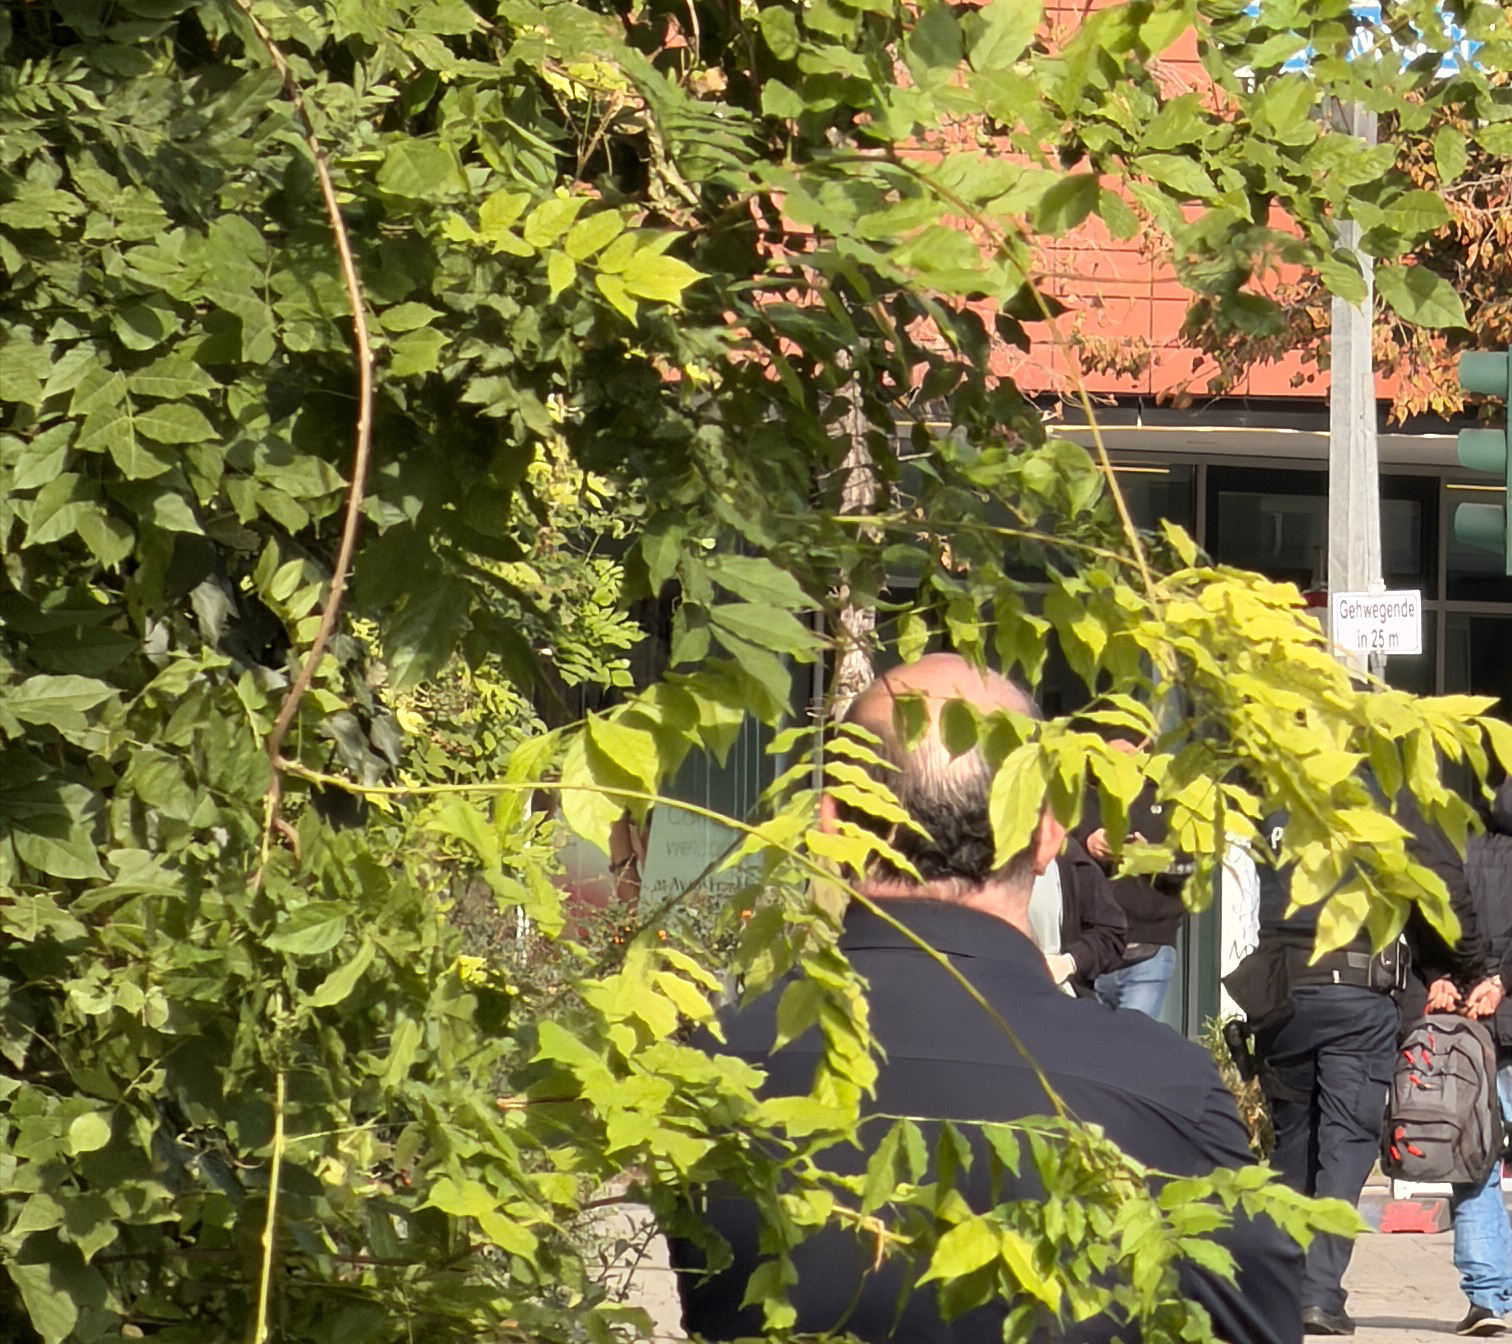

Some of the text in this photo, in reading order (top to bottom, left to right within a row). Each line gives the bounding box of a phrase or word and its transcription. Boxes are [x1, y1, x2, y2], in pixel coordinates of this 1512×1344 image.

[1339, 598, 1415, 624] Gehwegende
[1356, 628, 1399, 649] in 25 m
